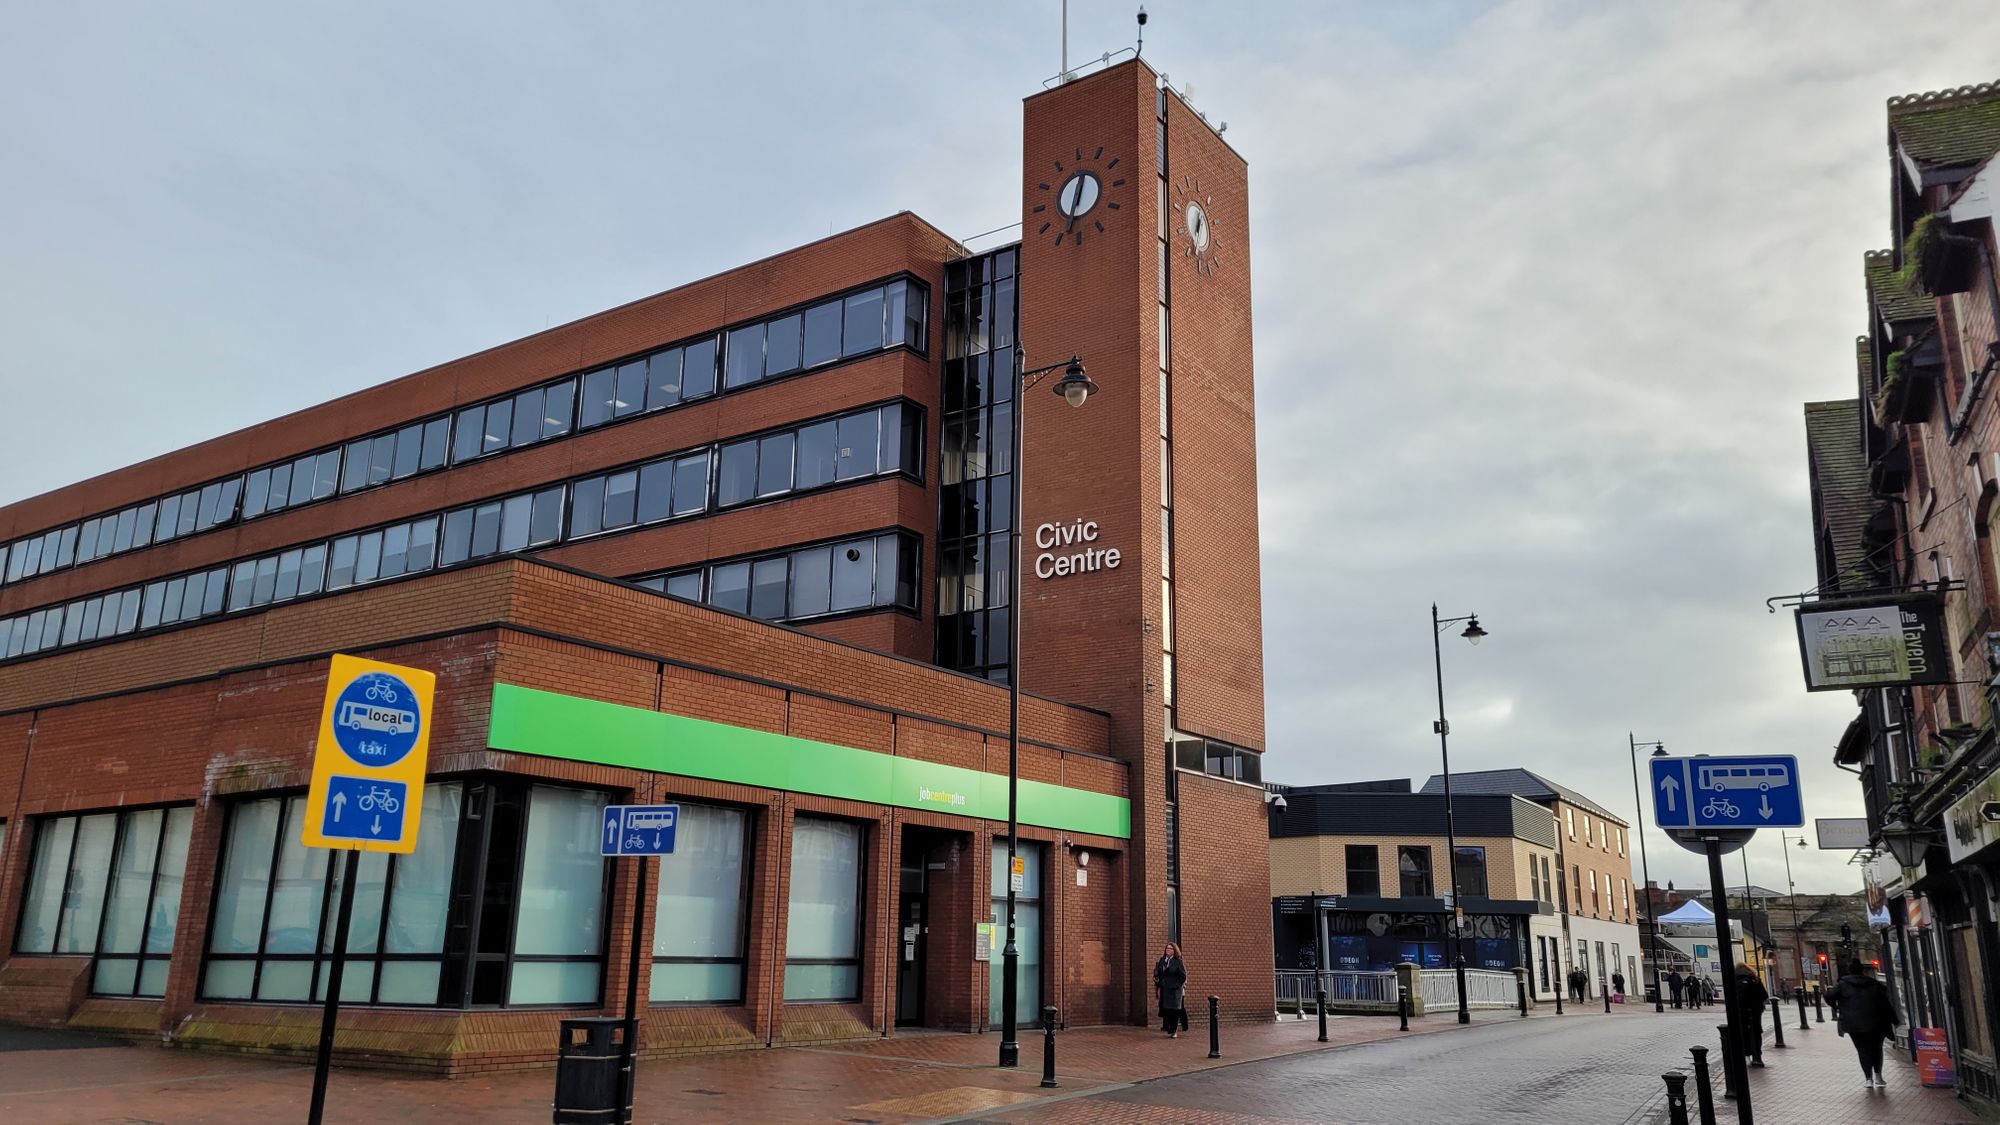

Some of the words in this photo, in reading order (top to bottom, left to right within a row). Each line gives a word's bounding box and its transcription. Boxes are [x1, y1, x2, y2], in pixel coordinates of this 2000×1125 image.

[1035, 518, 1098, 549] Civic
[1035, 548, 1121, 579] Centre
[1901, 611, 1918, 623] The
[1903, 623, 1927, 674] Tavern
[368, 708, 402, 725] local
[359, 741, 387, 756] taxi
